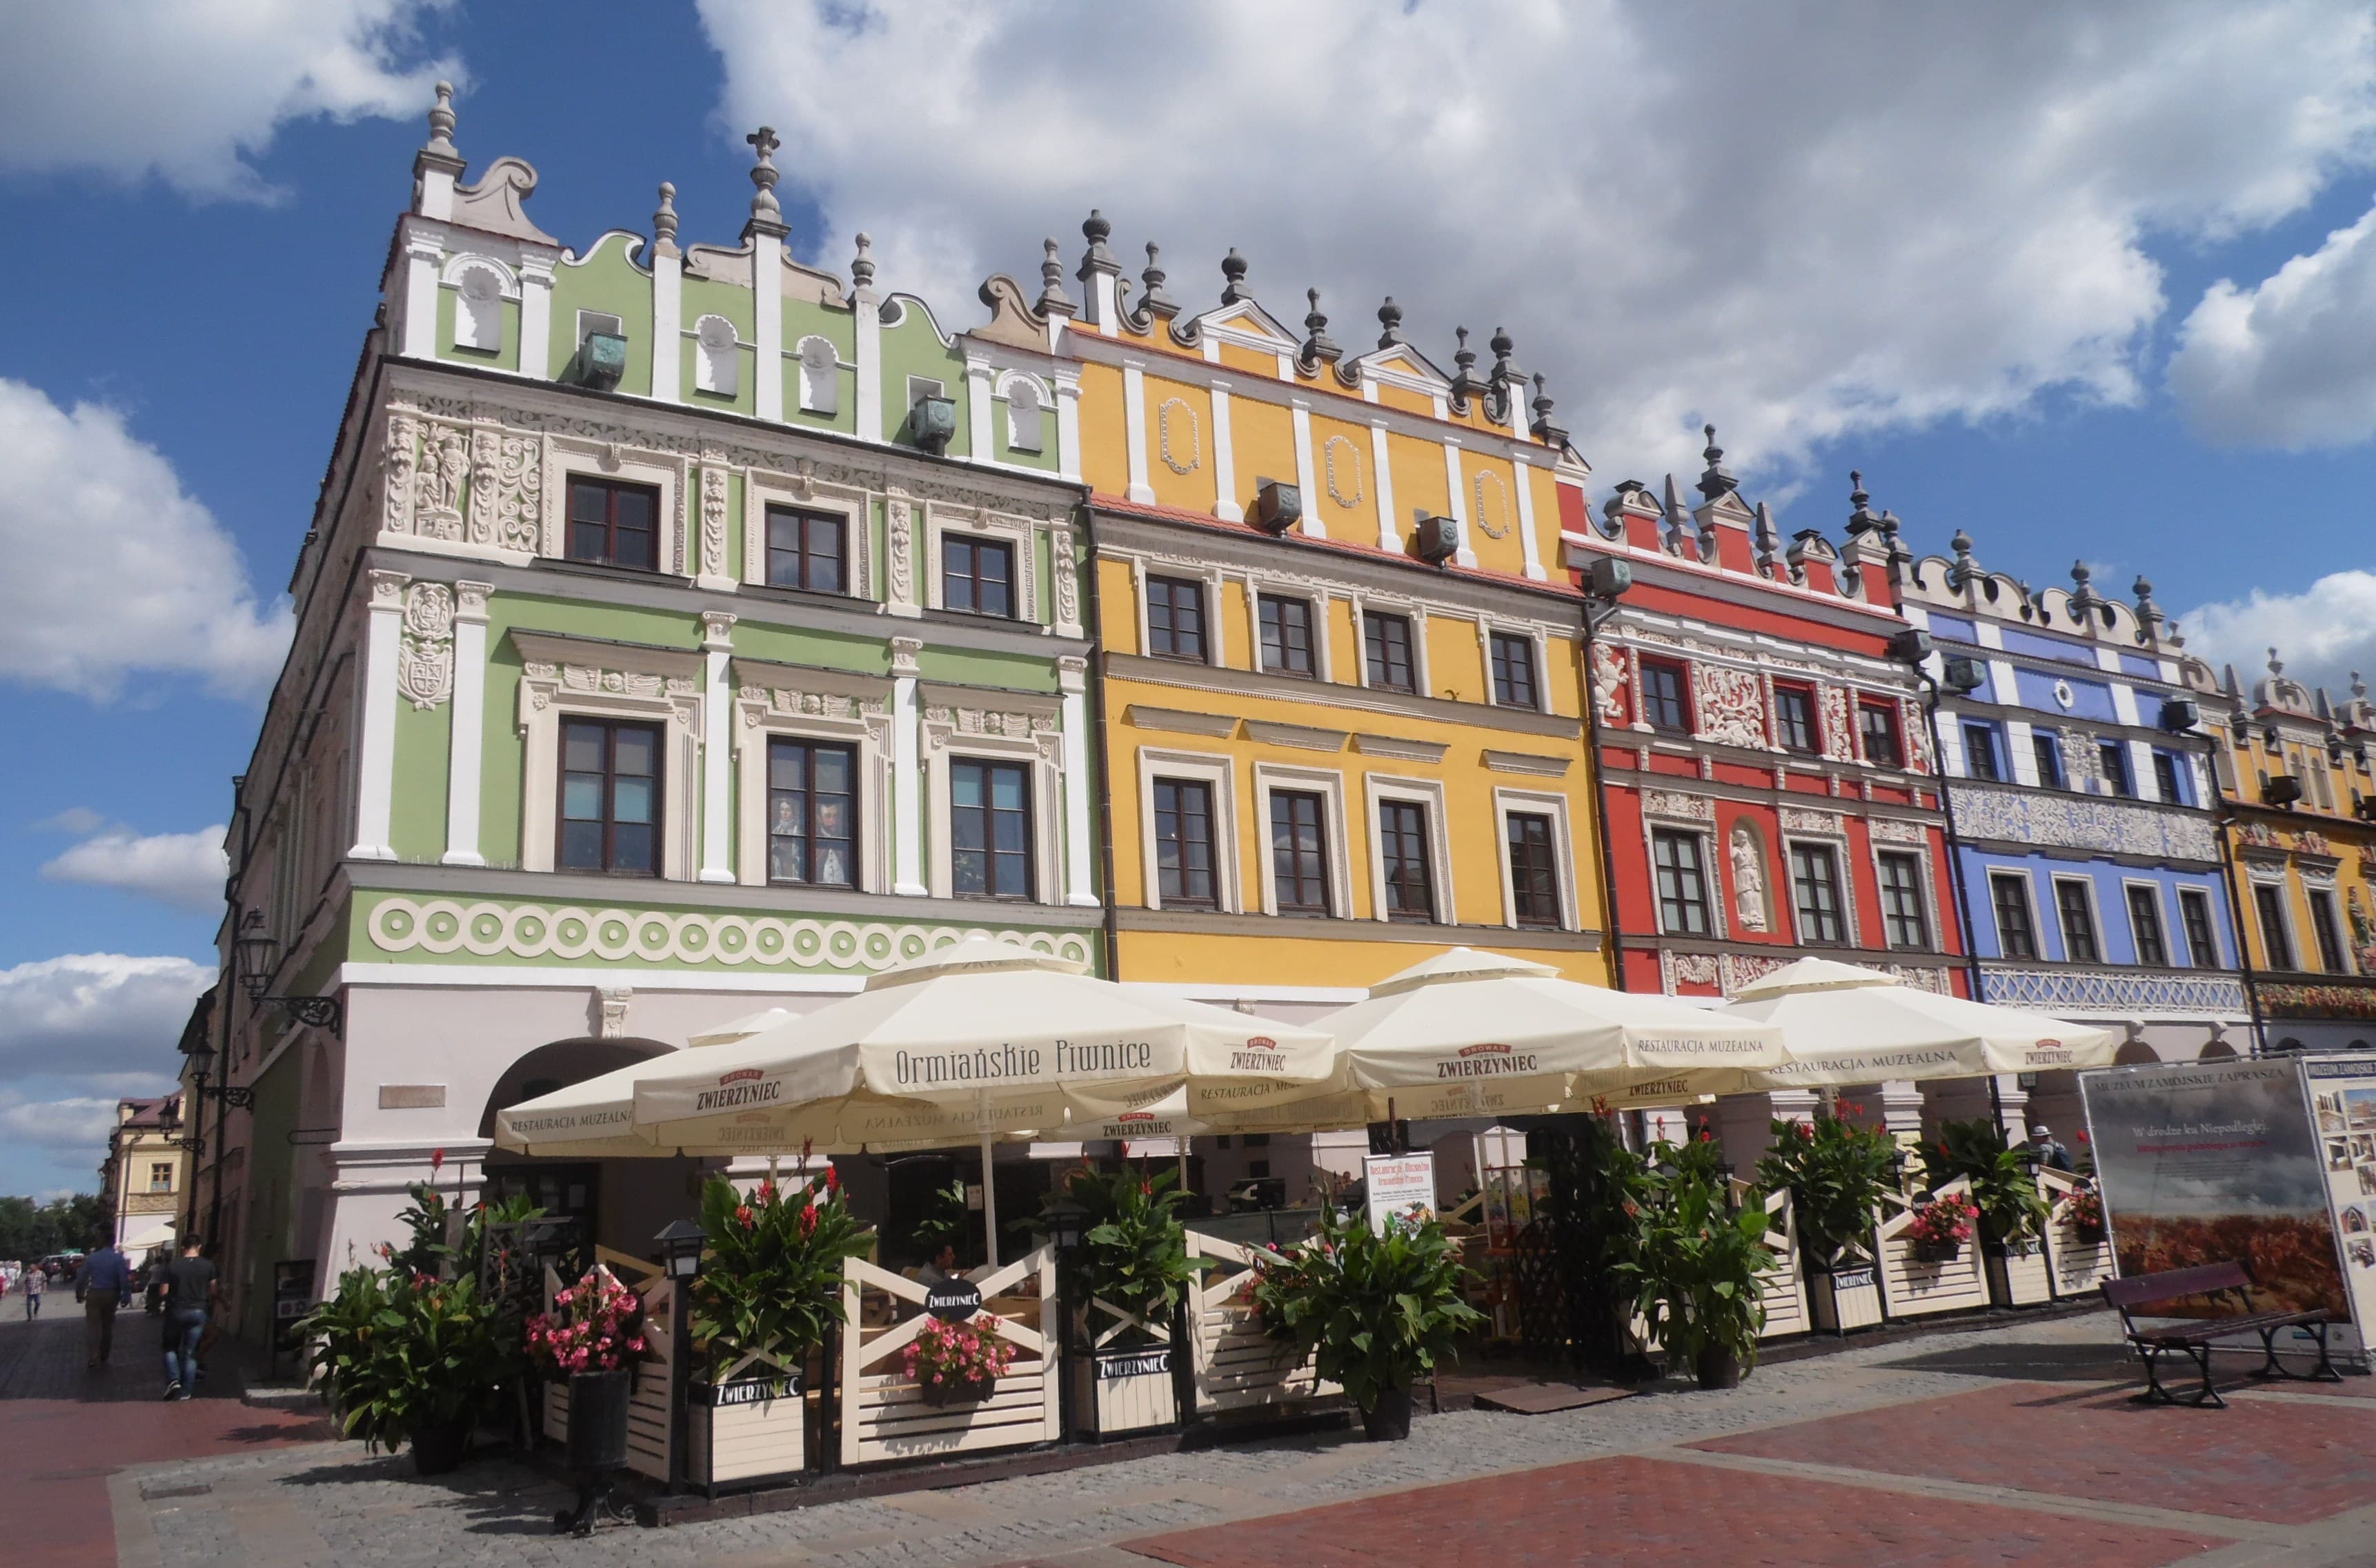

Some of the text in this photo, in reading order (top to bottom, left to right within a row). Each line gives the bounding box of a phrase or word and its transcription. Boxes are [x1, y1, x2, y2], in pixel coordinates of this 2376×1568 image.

[1463, 1044, 1506, 1055] BROWAR
[1638, 1040, 1764, 1054] RESTAURACJA MUZEALNA
[896, 1040, 1151, 1084] Ormiańskie Piwnice
[1230, 1051, 1286, 1071] ZWIERZYNIEC
[1872, 1051, 1957, 1069] MUZEALNA
[2026, 1051, 2072, 1064] ZWIERZYNIEC
[1437, 1055, 1537, 1078] ZWIERZYNIEC
[2095, 1080, 2145, 1091] MUZEUM
[2218, 1068, 2285, 1083] ZAPRASZA
[697, 1081, 780, 1110] ZWIERZYNIEC
[1201, 1084, 1270, 1100] RESTAURACJA
[1630, 1080, 1688, 1096] ZWIERZYNIEC
[511, 1116, 575, 1133] RESTAURACJA
[1103, 1121, 1171, 1137] ZWIERZYNIEC
[2132, 1127, 2144, 1137] W
[2184, 1122, 2198, 1135] ku
[929, 1293, 979, 1309] ZWIERZYNIEC
[1100, 1354, 1169, 1378] ZWIERZYNIEC
